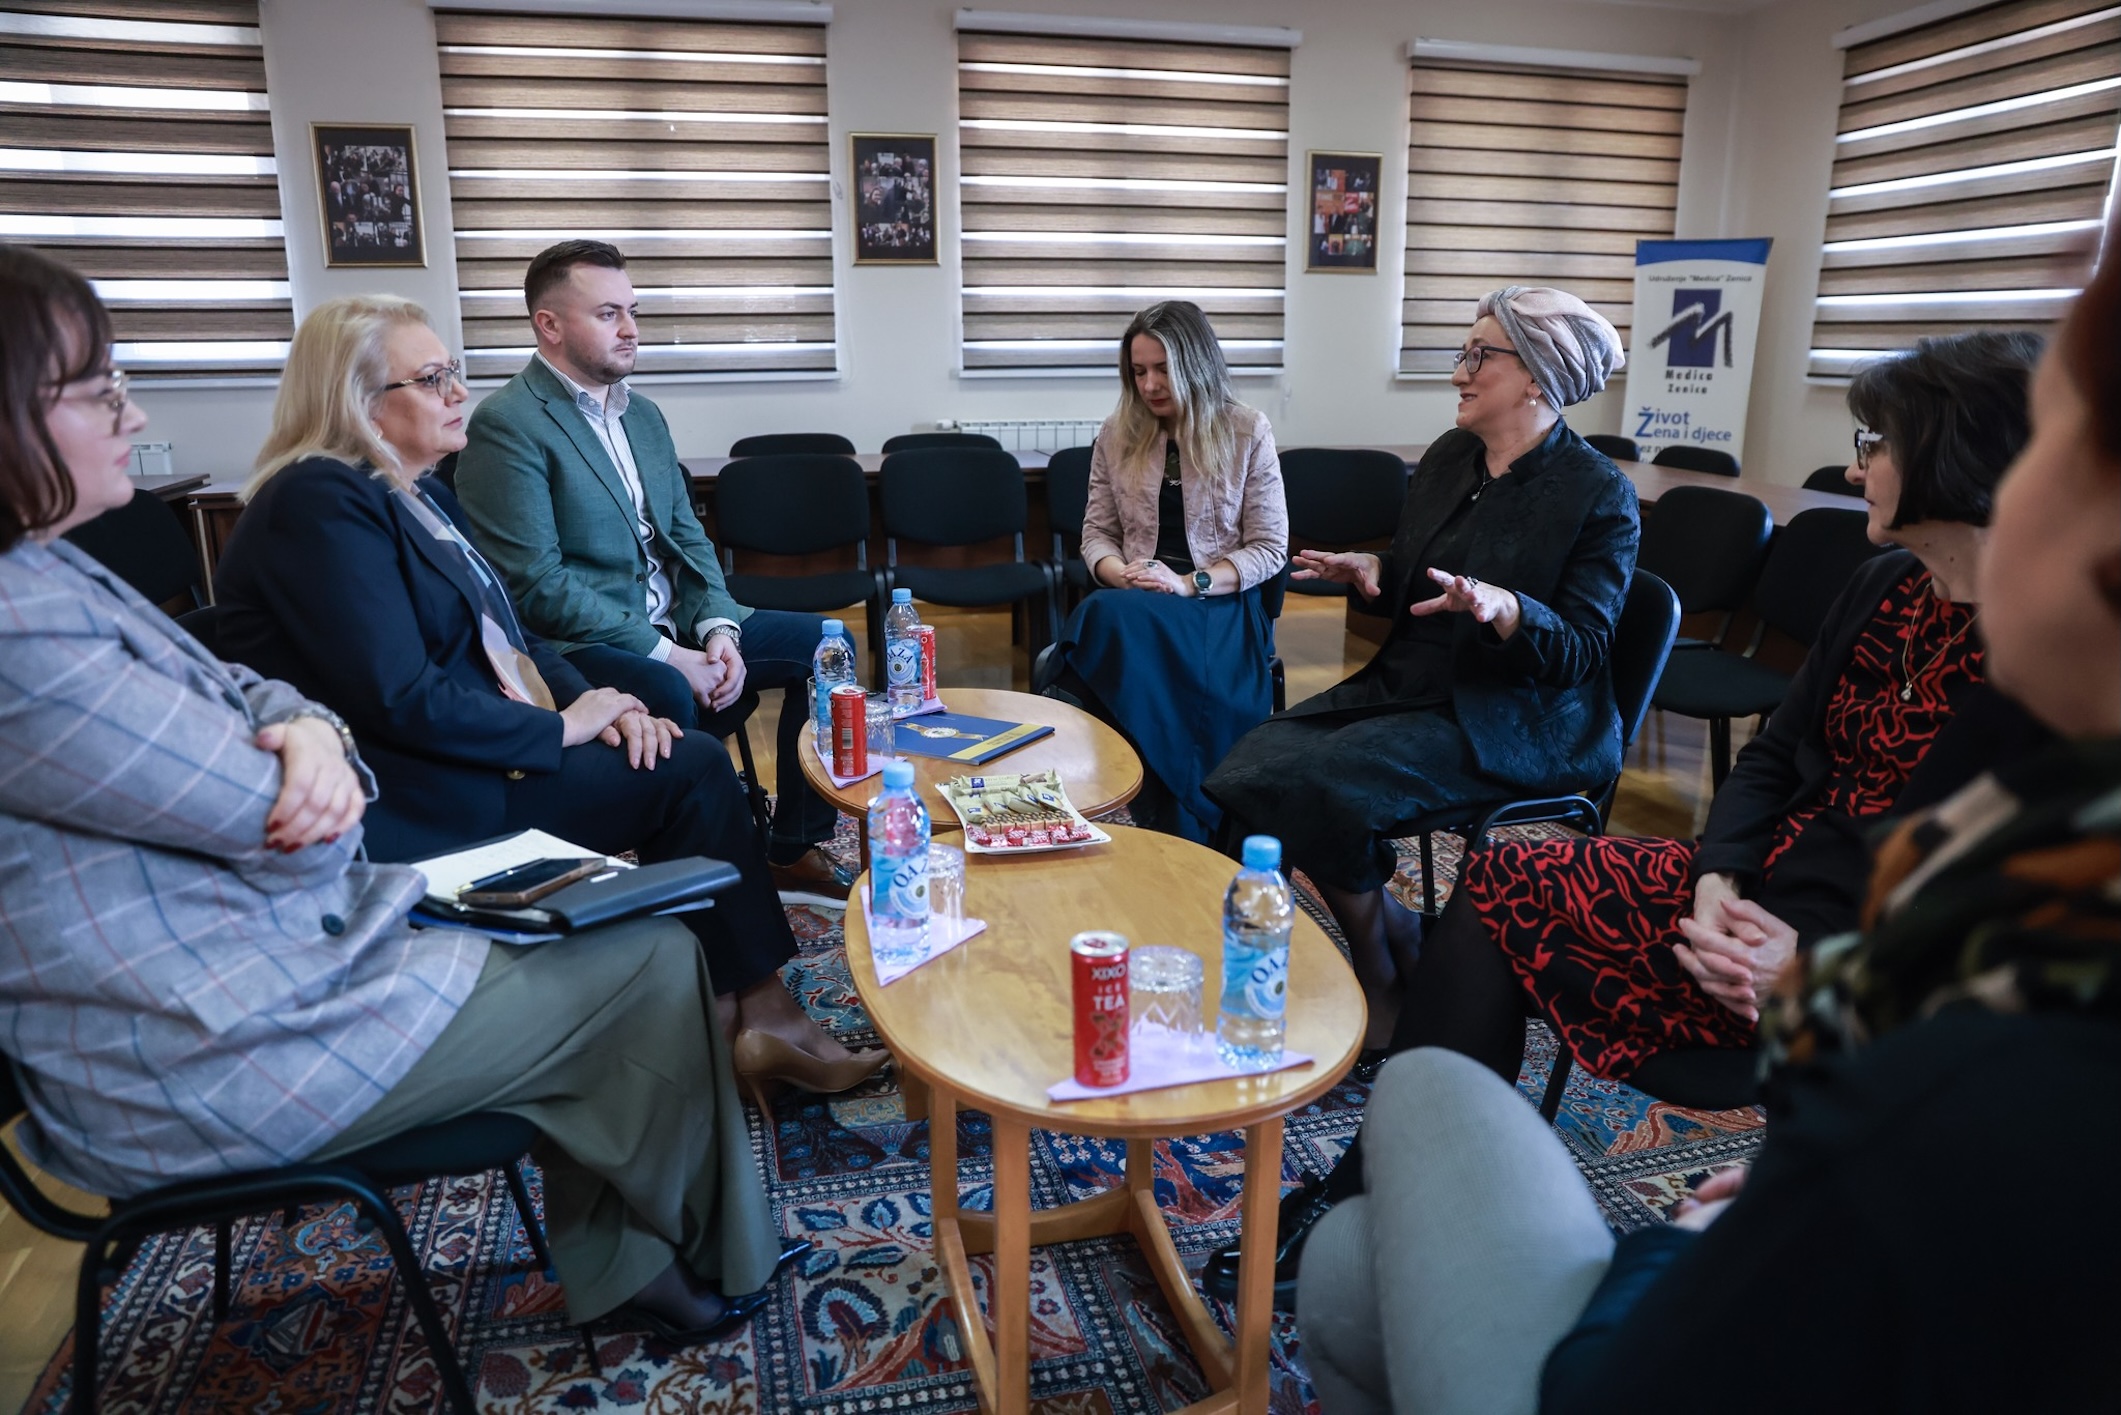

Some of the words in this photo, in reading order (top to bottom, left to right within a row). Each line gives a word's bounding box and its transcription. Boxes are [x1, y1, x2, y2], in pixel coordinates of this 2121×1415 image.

[1665, 369, 1713, 381] Medica
[1667, 383, 1708, 395] Zenica
[1635, 406, 1690, 434] Život
[1684, 426, 1689, 439] i
[1692, 426, 1732, 444] djece
[1091, 964, 1127, 981] XIXO
[1093, 994, 1126, 1011] TEA
